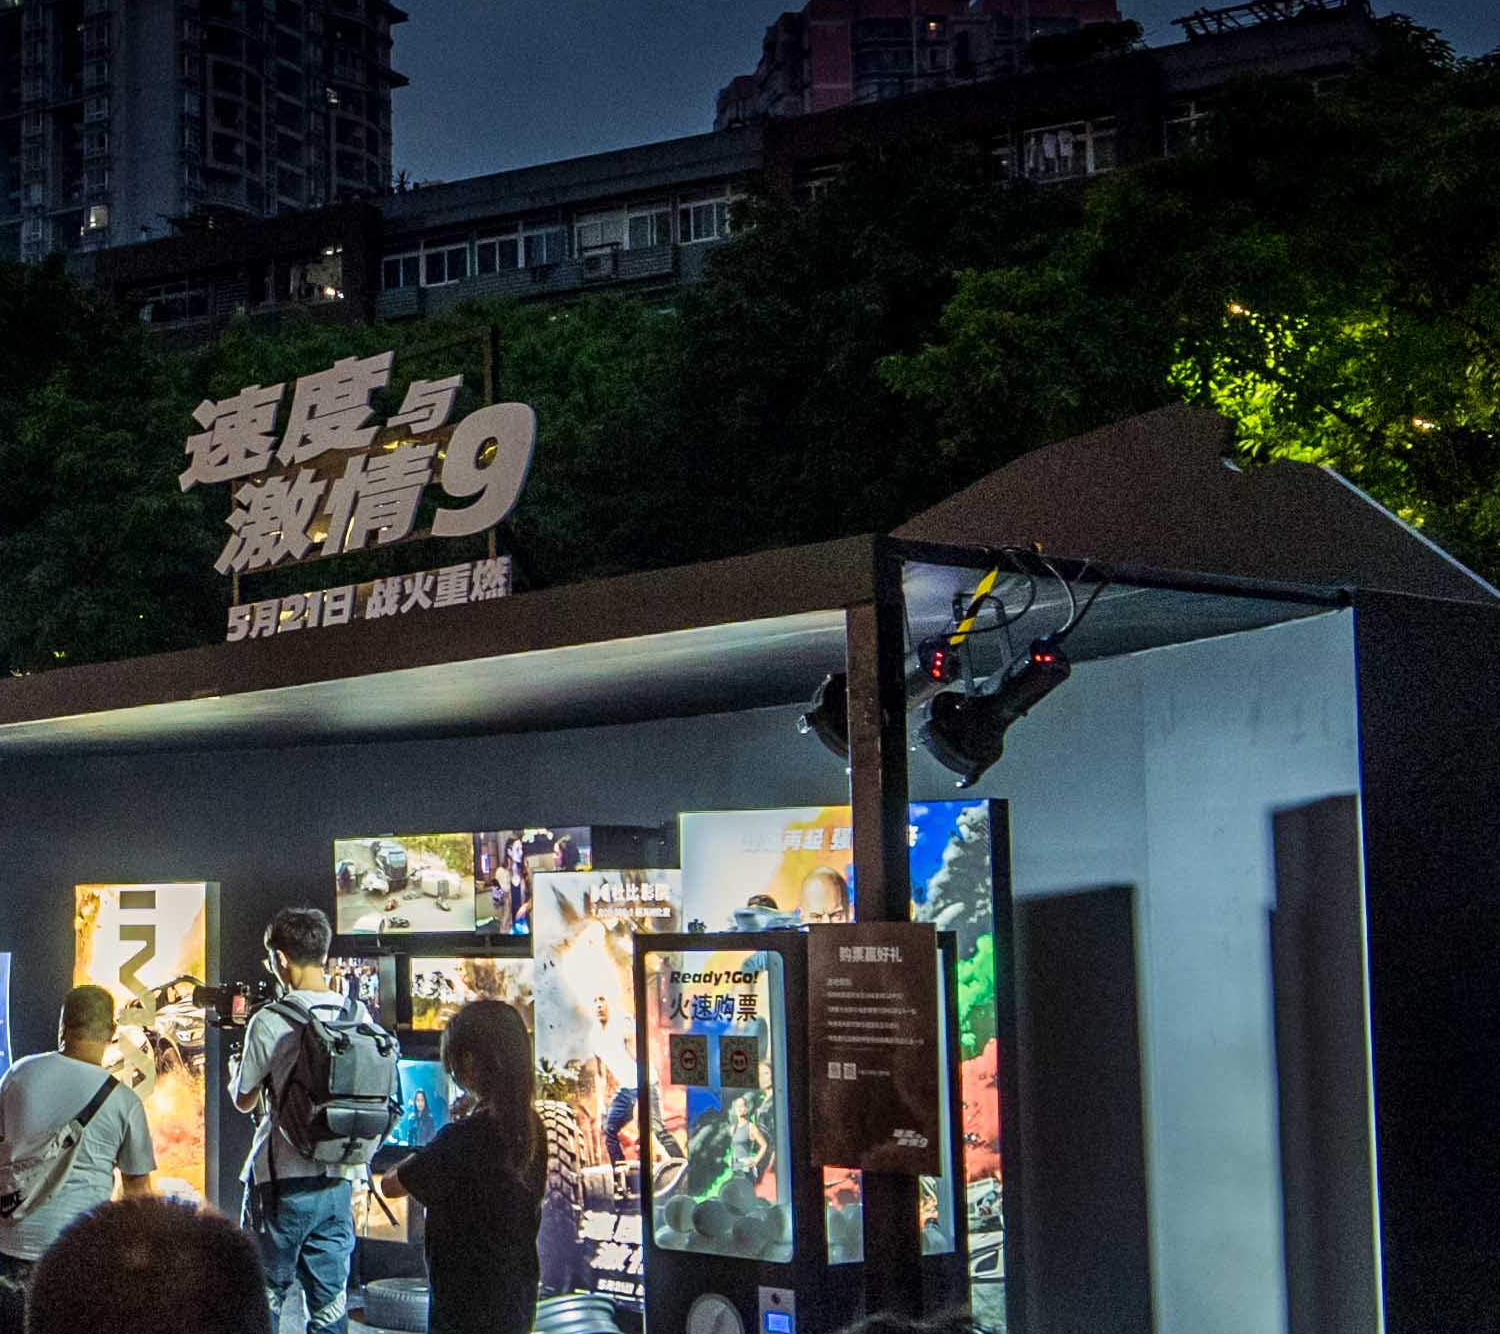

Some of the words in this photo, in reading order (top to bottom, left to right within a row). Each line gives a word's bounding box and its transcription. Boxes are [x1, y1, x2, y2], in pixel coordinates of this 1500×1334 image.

[178, 350, 464, 493] 速度与
[213, 401, 538, 576] 激情9
[226, 584, 358, 643] 5月21日
[364, 555, 514, 621] 战火重燃
[669, 992, 759, 1022] 火速购票
